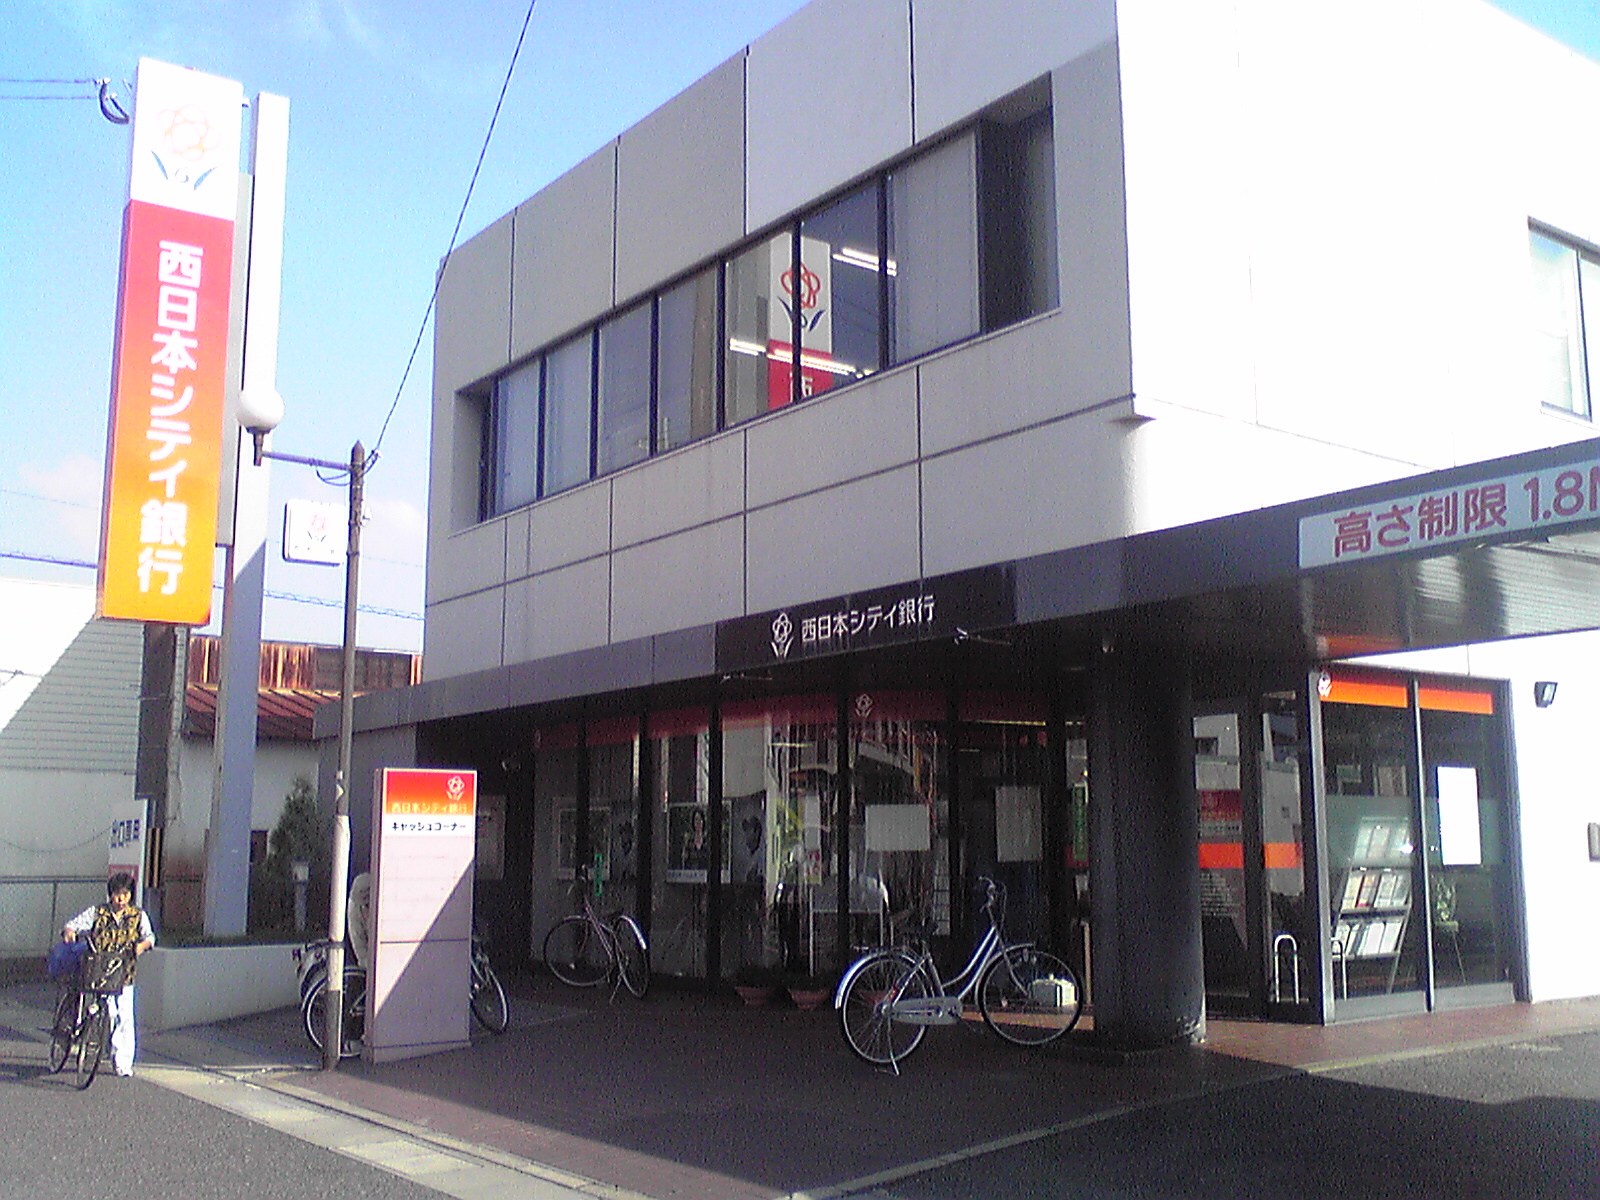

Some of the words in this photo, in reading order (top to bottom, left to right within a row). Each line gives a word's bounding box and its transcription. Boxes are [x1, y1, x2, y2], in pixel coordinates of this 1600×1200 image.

[137, 239, 204, 595] 西日本シティ銀行
[1333, 483, 1508, 558] 高さ制限
[801, 594, 935, 642] 西日本シティ銀行
[391, 821, 467, 831] キャッシュコーナー
